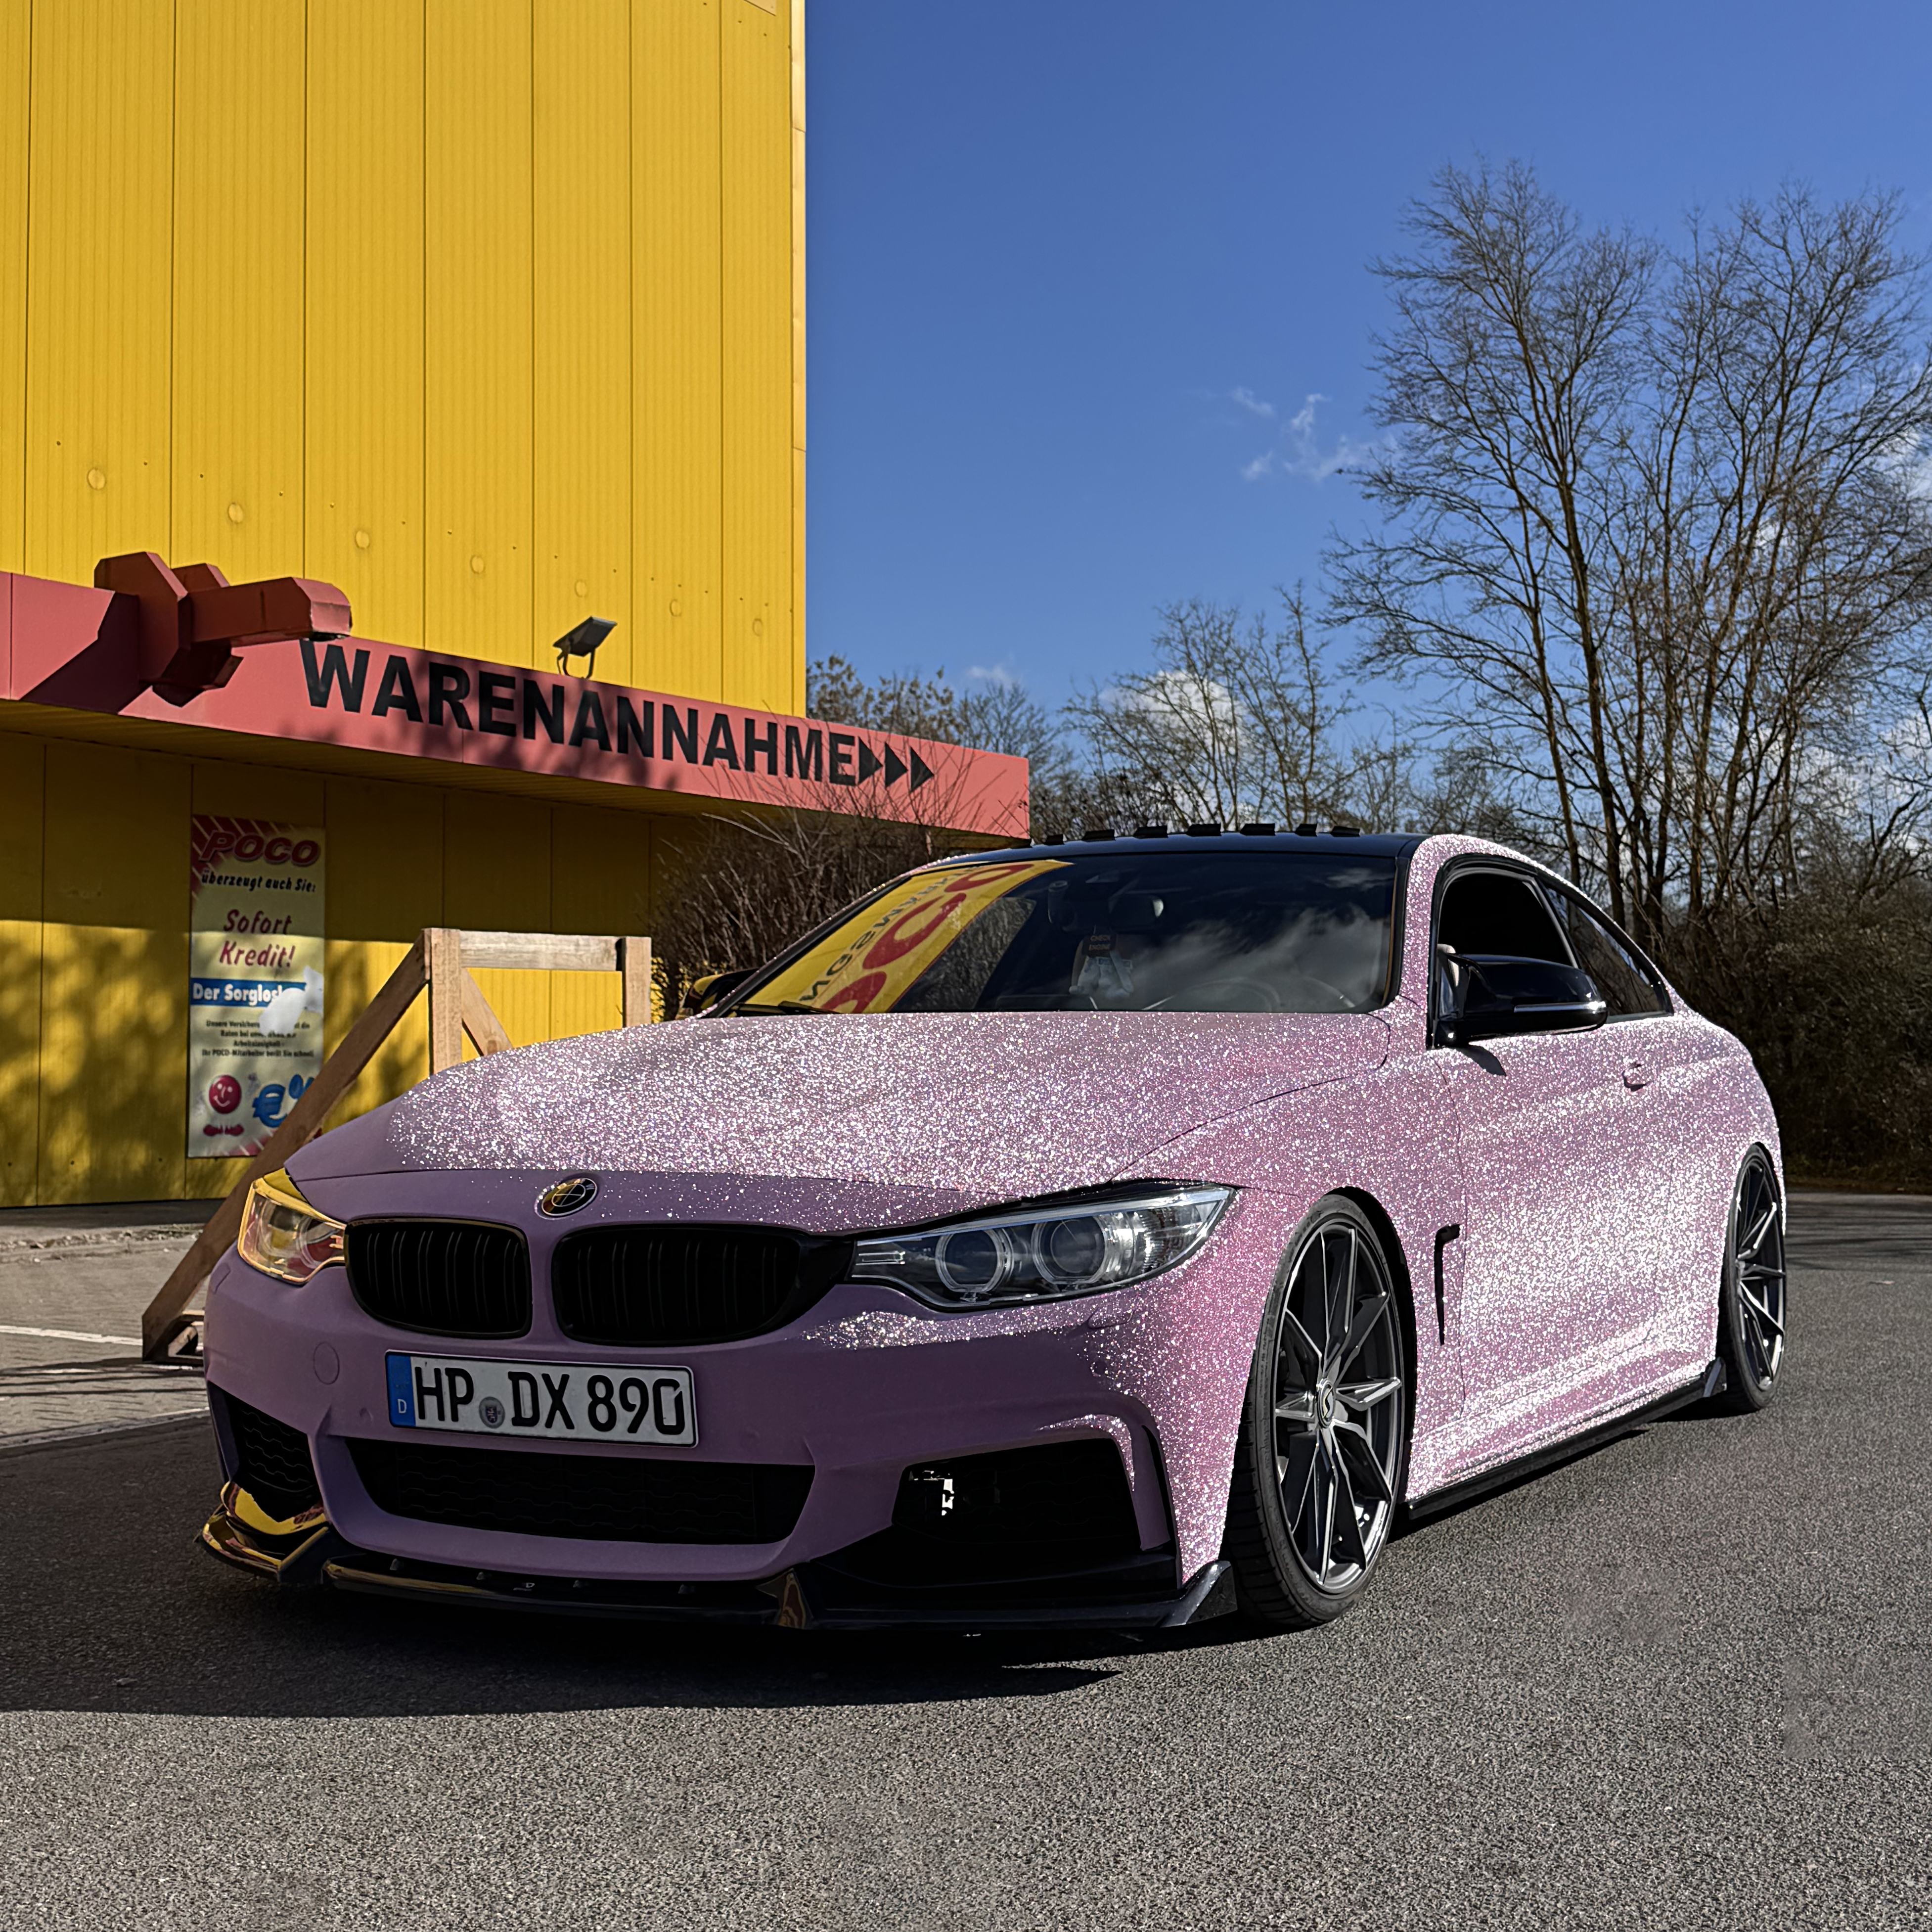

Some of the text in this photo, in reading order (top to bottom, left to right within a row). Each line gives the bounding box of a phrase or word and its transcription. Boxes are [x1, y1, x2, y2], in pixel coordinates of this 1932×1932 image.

[299, 639, 856, 786] WARENANNAHME
[198, 829, 320, 867] POCO
[201, 870, 315, 892] überzeugt auch Sie:
[224, 909, 291, 935] Sofort
[220, 940, 296, 967] Kredit!
[192, 983, 220, 1001] Der
[398, 1399, 406, 1414] D
[414, 1366, 685, 1435] HP DX 890
